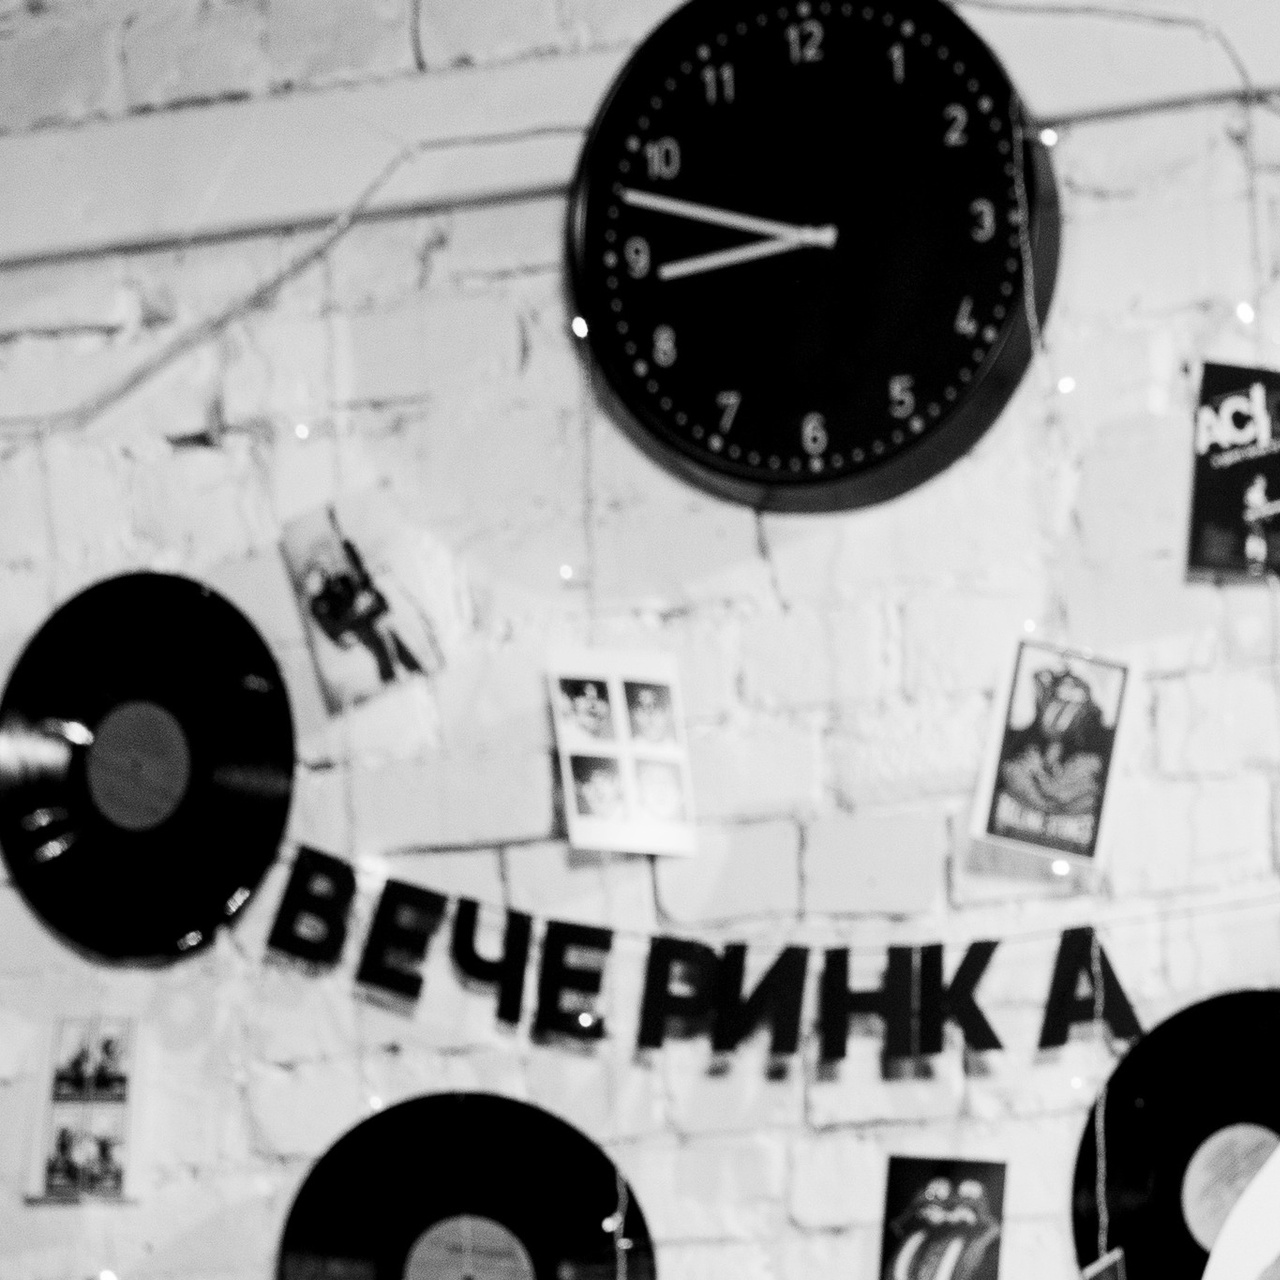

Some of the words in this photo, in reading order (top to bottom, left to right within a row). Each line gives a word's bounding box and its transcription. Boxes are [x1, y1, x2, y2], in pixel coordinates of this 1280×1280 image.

[786, 18, 824, 62] 12
[702, 63, 735, 104] 11
[890, 42, 905, 83] 1
[944, 102, 968, 147] 2
[644, 136, 681, 180] 10
[971, 197, 996, 243] 3
[624, 235, 651, 280] 9
[652, 324, 677, 368] 8
[716, 390, 741, 434] 7
[889, 373, 915, 419] 5
[801, 411, 828, 456] 6
[264, 843, 1141, 1058] ВЕЧЕРИНКА
